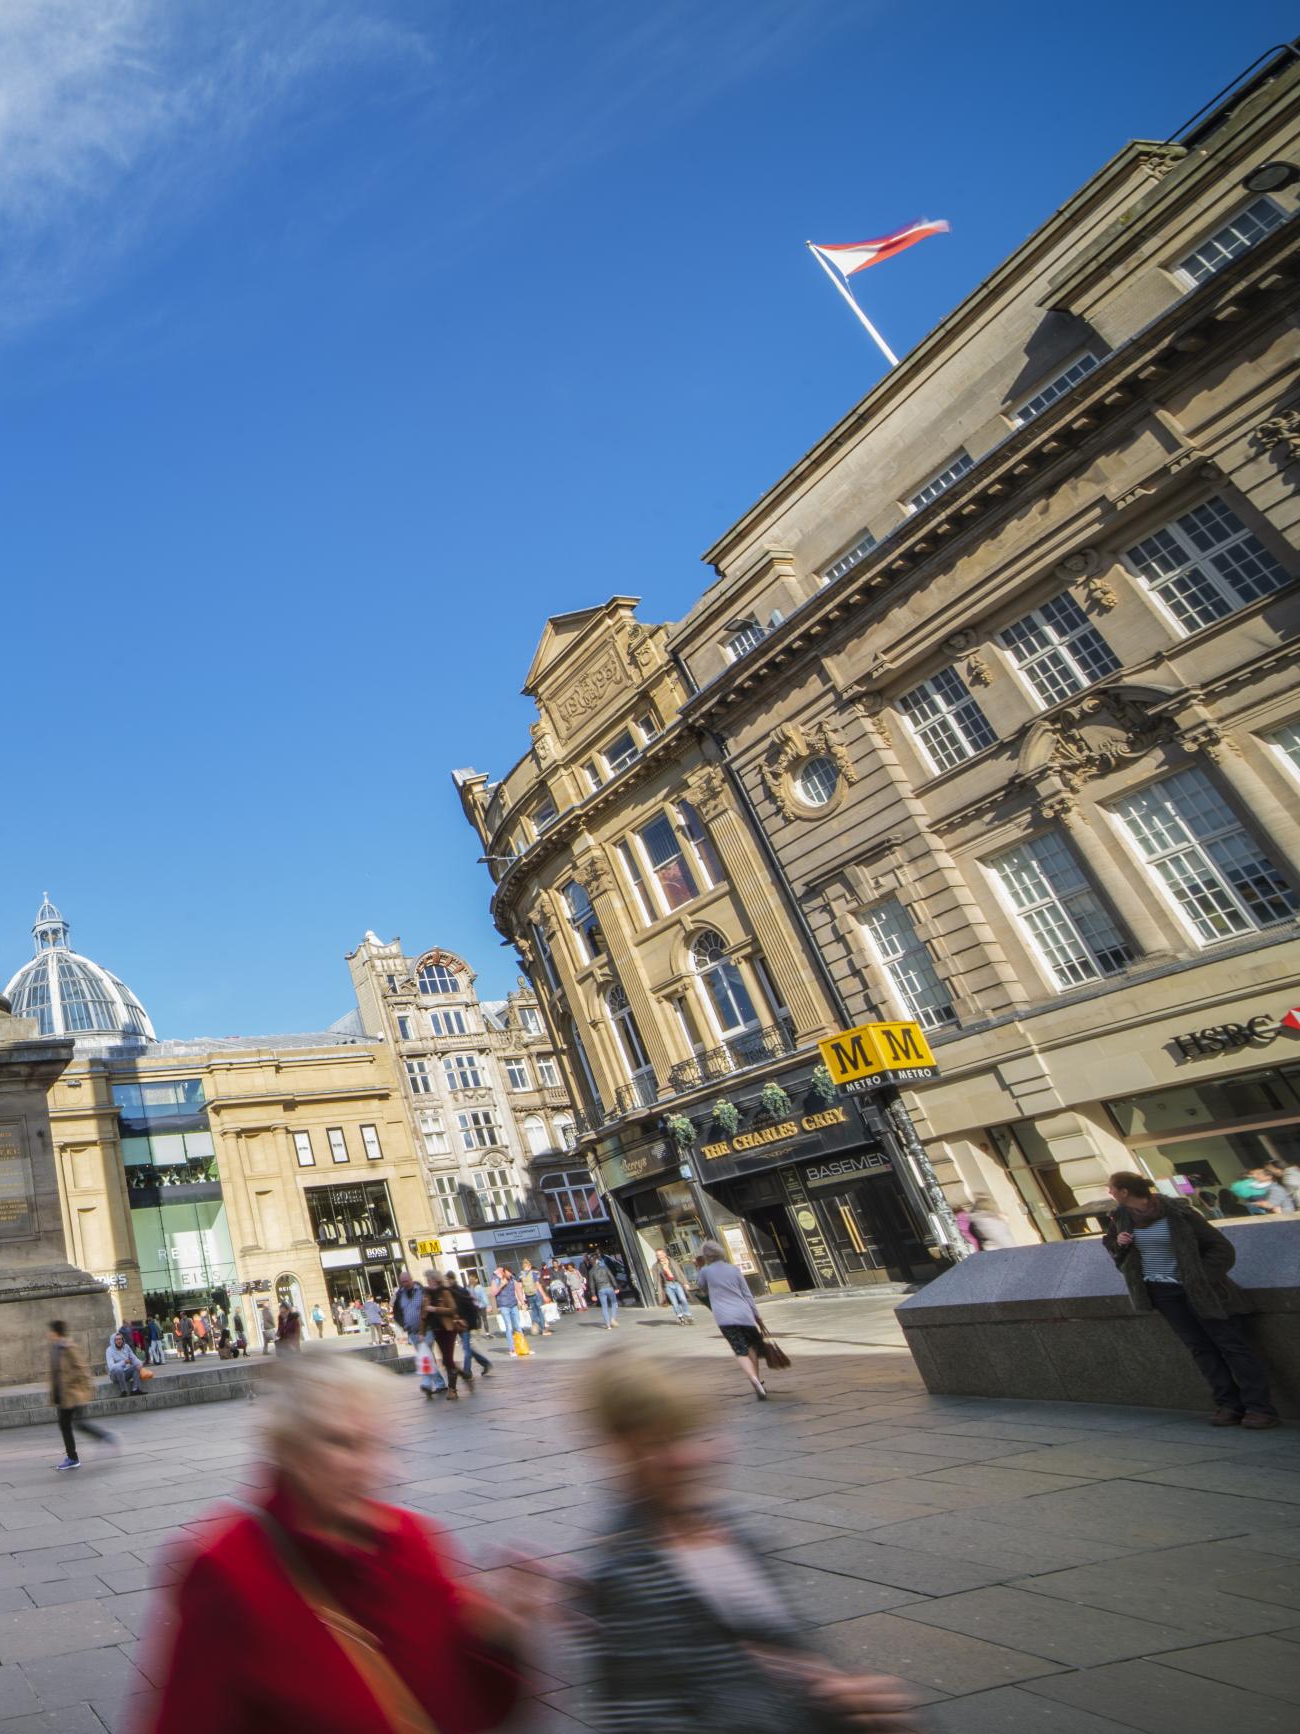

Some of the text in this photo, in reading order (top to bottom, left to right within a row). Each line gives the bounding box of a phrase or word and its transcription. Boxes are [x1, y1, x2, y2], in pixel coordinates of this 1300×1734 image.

[881, 1028, 924, 1061] M
[1166, 1013, 1277, 1063] HSBC
[830, 1035, 874, 1075] M
[845, 1075, 881, 1092] METRO
[898, 1068, 932, 1079] METRO
[702, 1140, 731, 1160] THE
[732, 1121, 798, 1151] CHARLES
[801, 1106, 849, 1132] GREY
[366, 1246, 387, 1256] BOSS
[429, 1242, 439, 1252] M
